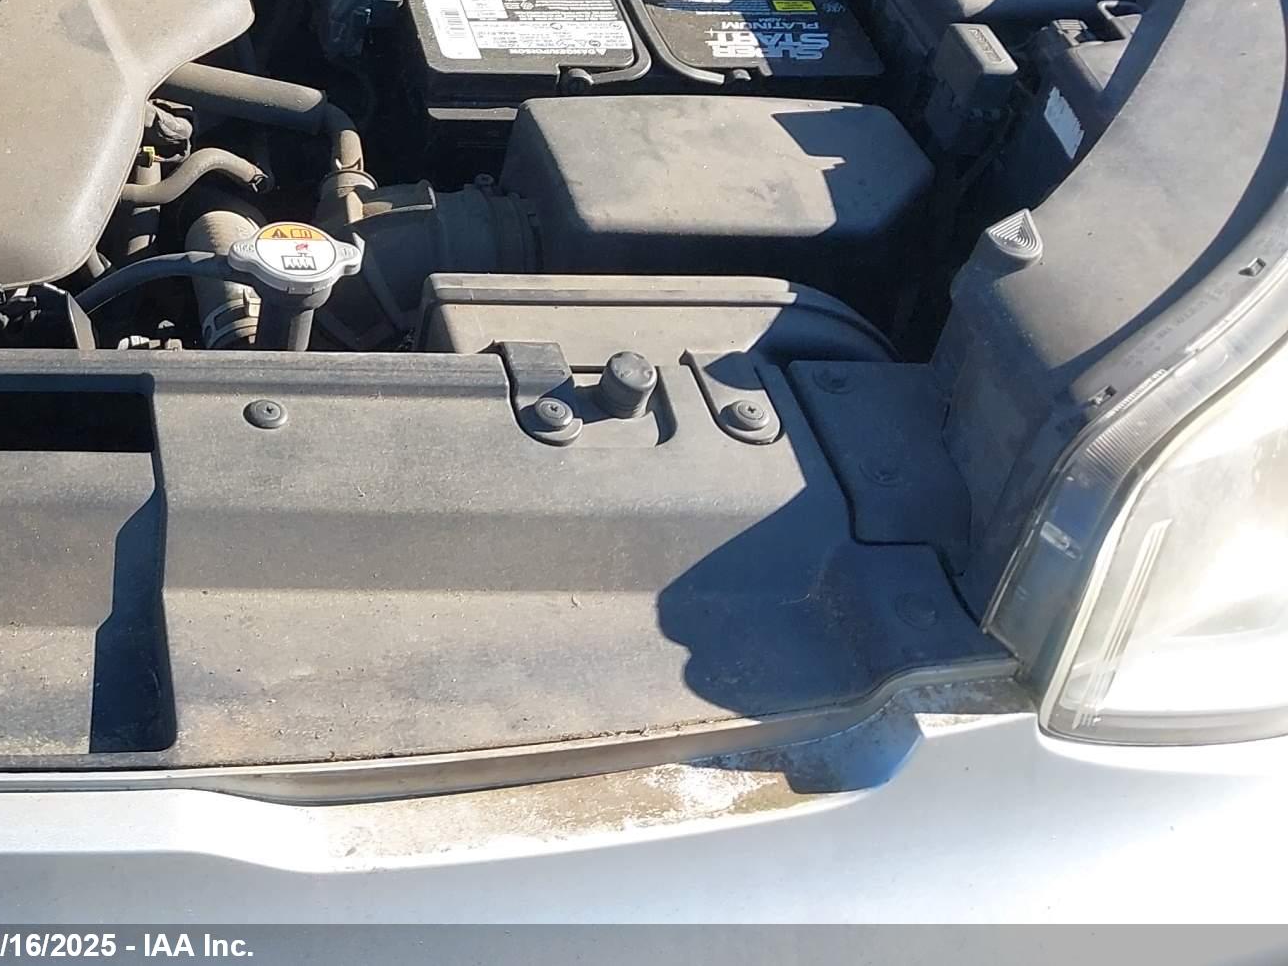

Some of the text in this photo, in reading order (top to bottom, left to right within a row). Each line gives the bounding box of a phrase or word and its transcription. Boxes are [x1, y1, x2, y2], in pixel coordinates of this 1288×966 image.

[721, 21, 819, 30] PLATINUM
[704, 29, 829, 48] START
[712, 44, 823, 59] SUPER
